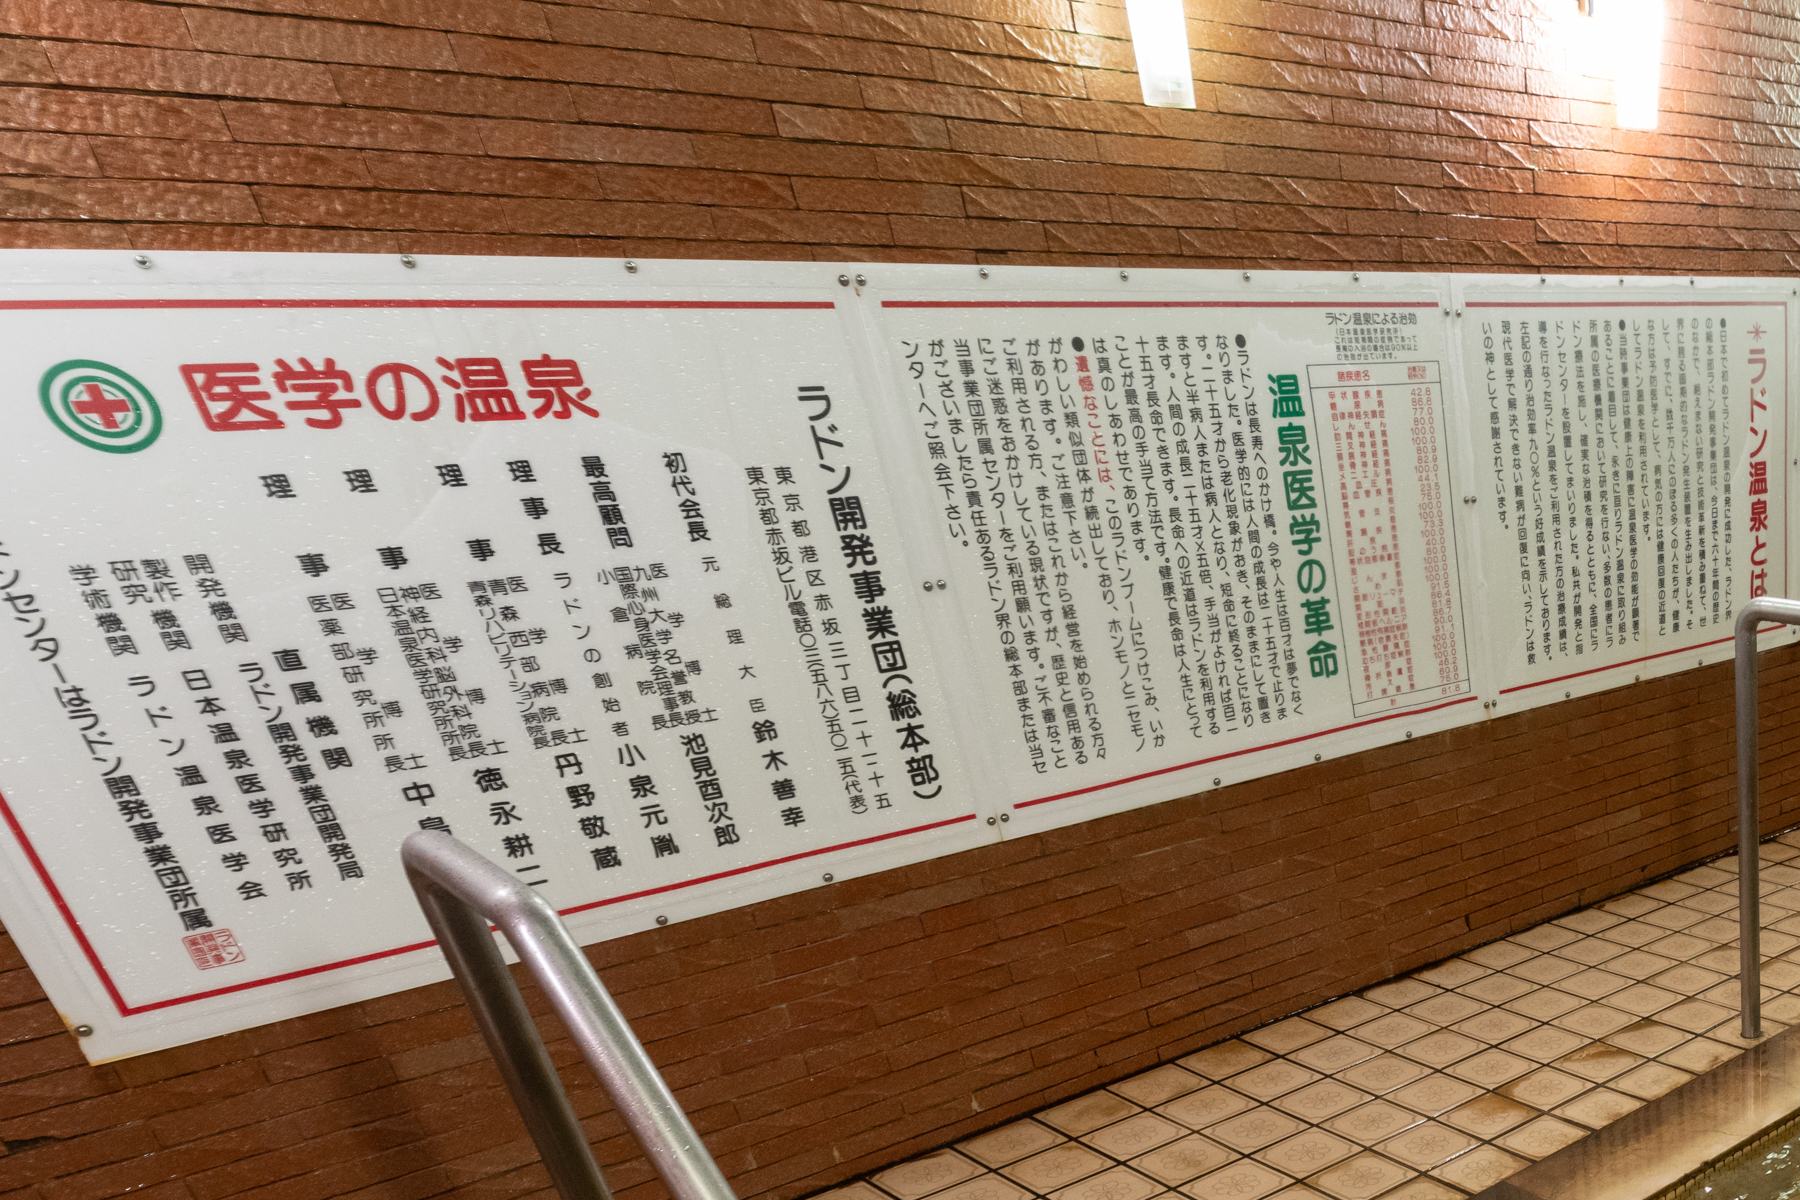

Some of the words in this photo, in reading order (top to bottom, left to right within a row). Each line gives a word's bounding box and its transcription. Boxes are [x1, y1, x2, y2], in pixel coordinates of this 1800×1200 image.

[1325, 313, 1418, 325] ラドン温泉による治効
[180, 356, 600, 432] 医学の温泉
[902, 341, 969, 547] ンターへご照会下さい。
[1026, 338, 1088, 569] があります。ご注意下さい。
[1092, 338, 1150, 561] は真のしあわせであります。
[1409, 387, 1430, 395] 42.8
[1410, 426, 1434, 434] 100.0
[1411, 435, 1435, 444] 100.0
[1412, 406, 1432, 415] 77.0
[581, 456, 633, 549] 最高顧問
[1267, 373, 1338, 679] 温泉医学の革命
[1414, 463, 1438, 472] 100.0
[1418, 500, 1442, 509] 100.0
[1419, 509, 1442, 518] 100.0
[1421, 527, 1444, 537] 100.0
[1747, 348, 1768, 599] ラドン温泉とは
[258, 474, 330, 577] 理事
[330, 593, 428, 770] 医学博士
[342, 468, 408, 570] 理事
[419, 583, 509, 755] 医学博士
[435, 464, 496, 562] 理事
[506, 576, 588, 744] 医学博士
[506, 459, 564, 555] 理事長
[554, 572, 630, 737] ラドンの創始者
[651, 563, 719, 723] 医学博士
[662, 452, 711, 542] 初代会長
[702, 556, 766, 714] 元総理大臣
[751, 720, 806, 828] 鈴木善幸
[68, 563, 139, 657] 学術機関
[128, 676, 268, 900] ラドン温泉医学会
[183, 553, 249, 644] 開発機関
[238, 662, 364, 881] ラドン開発事業団開発局
[272, 649, 353, 770] 直属機関
[180, 670, 314, 892] 日本温泉医学研究所
[472, 767, 549, 886] 徳永耕二
[554, 752, 622, 870] 丹野敬蔵
